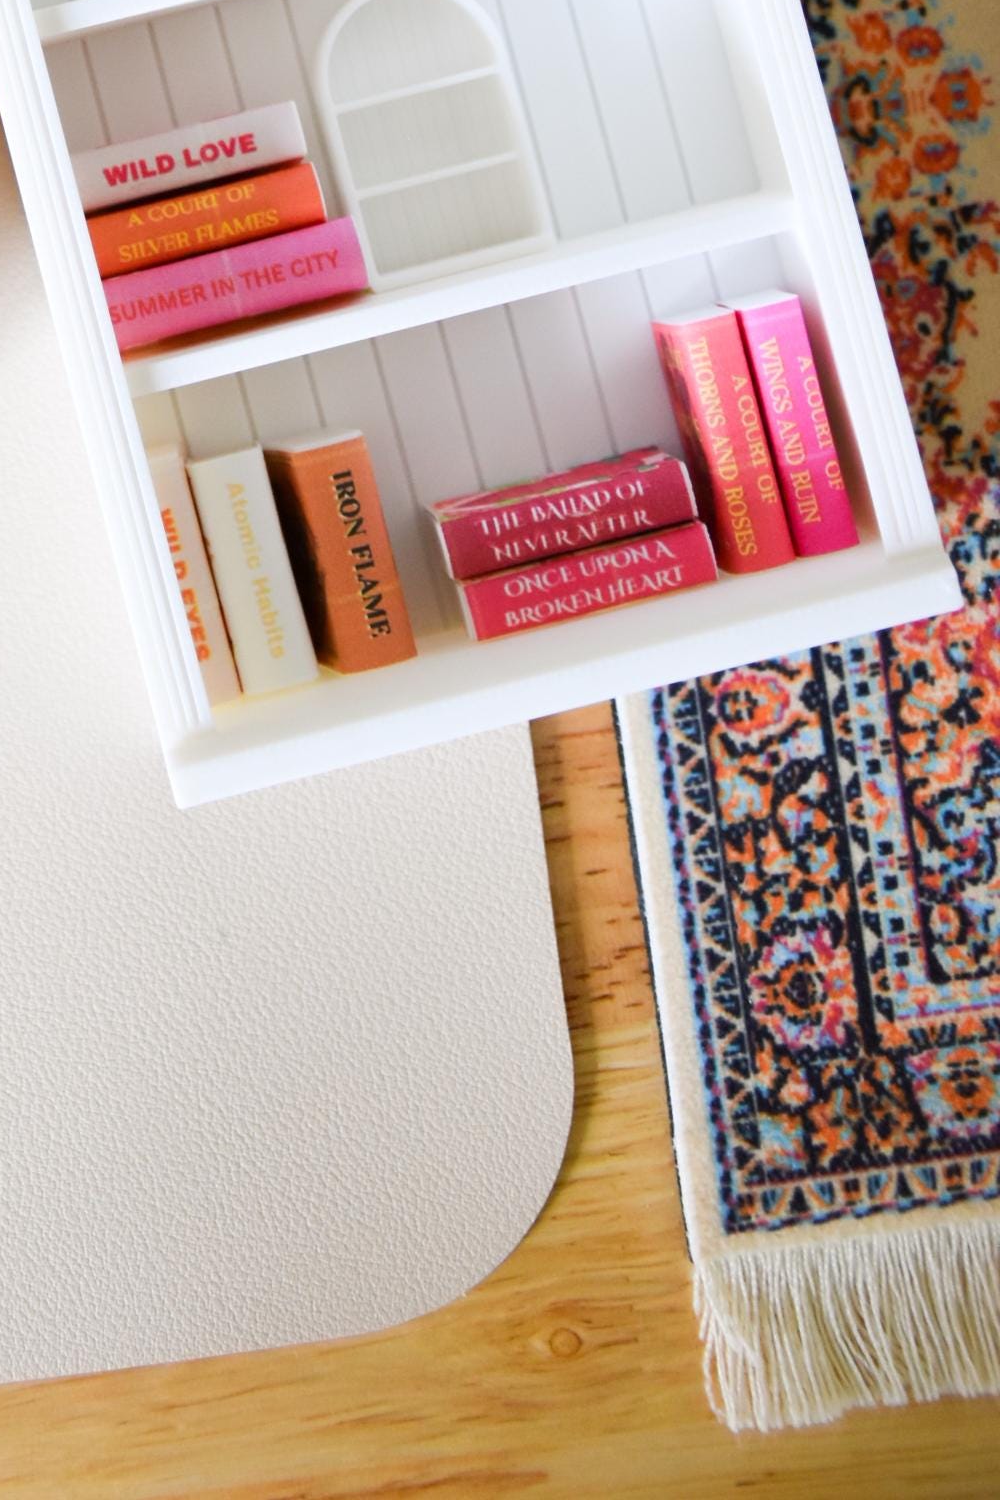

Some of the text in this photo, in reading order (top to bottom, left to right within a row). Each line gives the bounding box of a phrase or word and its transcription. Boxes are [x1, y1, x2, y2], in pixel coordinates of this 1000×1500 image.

[103, 133, 257, 187] WILD LOVE
[118, 210, 280, 263] SILVER FLAMES
[128, 183, 255, 227] A COURT OF
[110, 249, 338, 324] SUMMER IN THE CITY
[687, 337, 757, 556] THORNS AND ROSES
[732, 375, 778, 504] A COURT OF
[757, 337, 821, 524] WINGS AND RUIN
[797, 356, 845, 491] A COURT OF
[475, 479, 650, 536] THE BALLAD OF
[493, 509, 654, 562] NEVER AFTER
[228, 483, 284, 658] Atomic Habits
[330, 469, 391, 637] IRON FLAME
[504, 541, 676, 597] ONCE UPON A
[505, 566, 684, 628] BROKEN HEART
